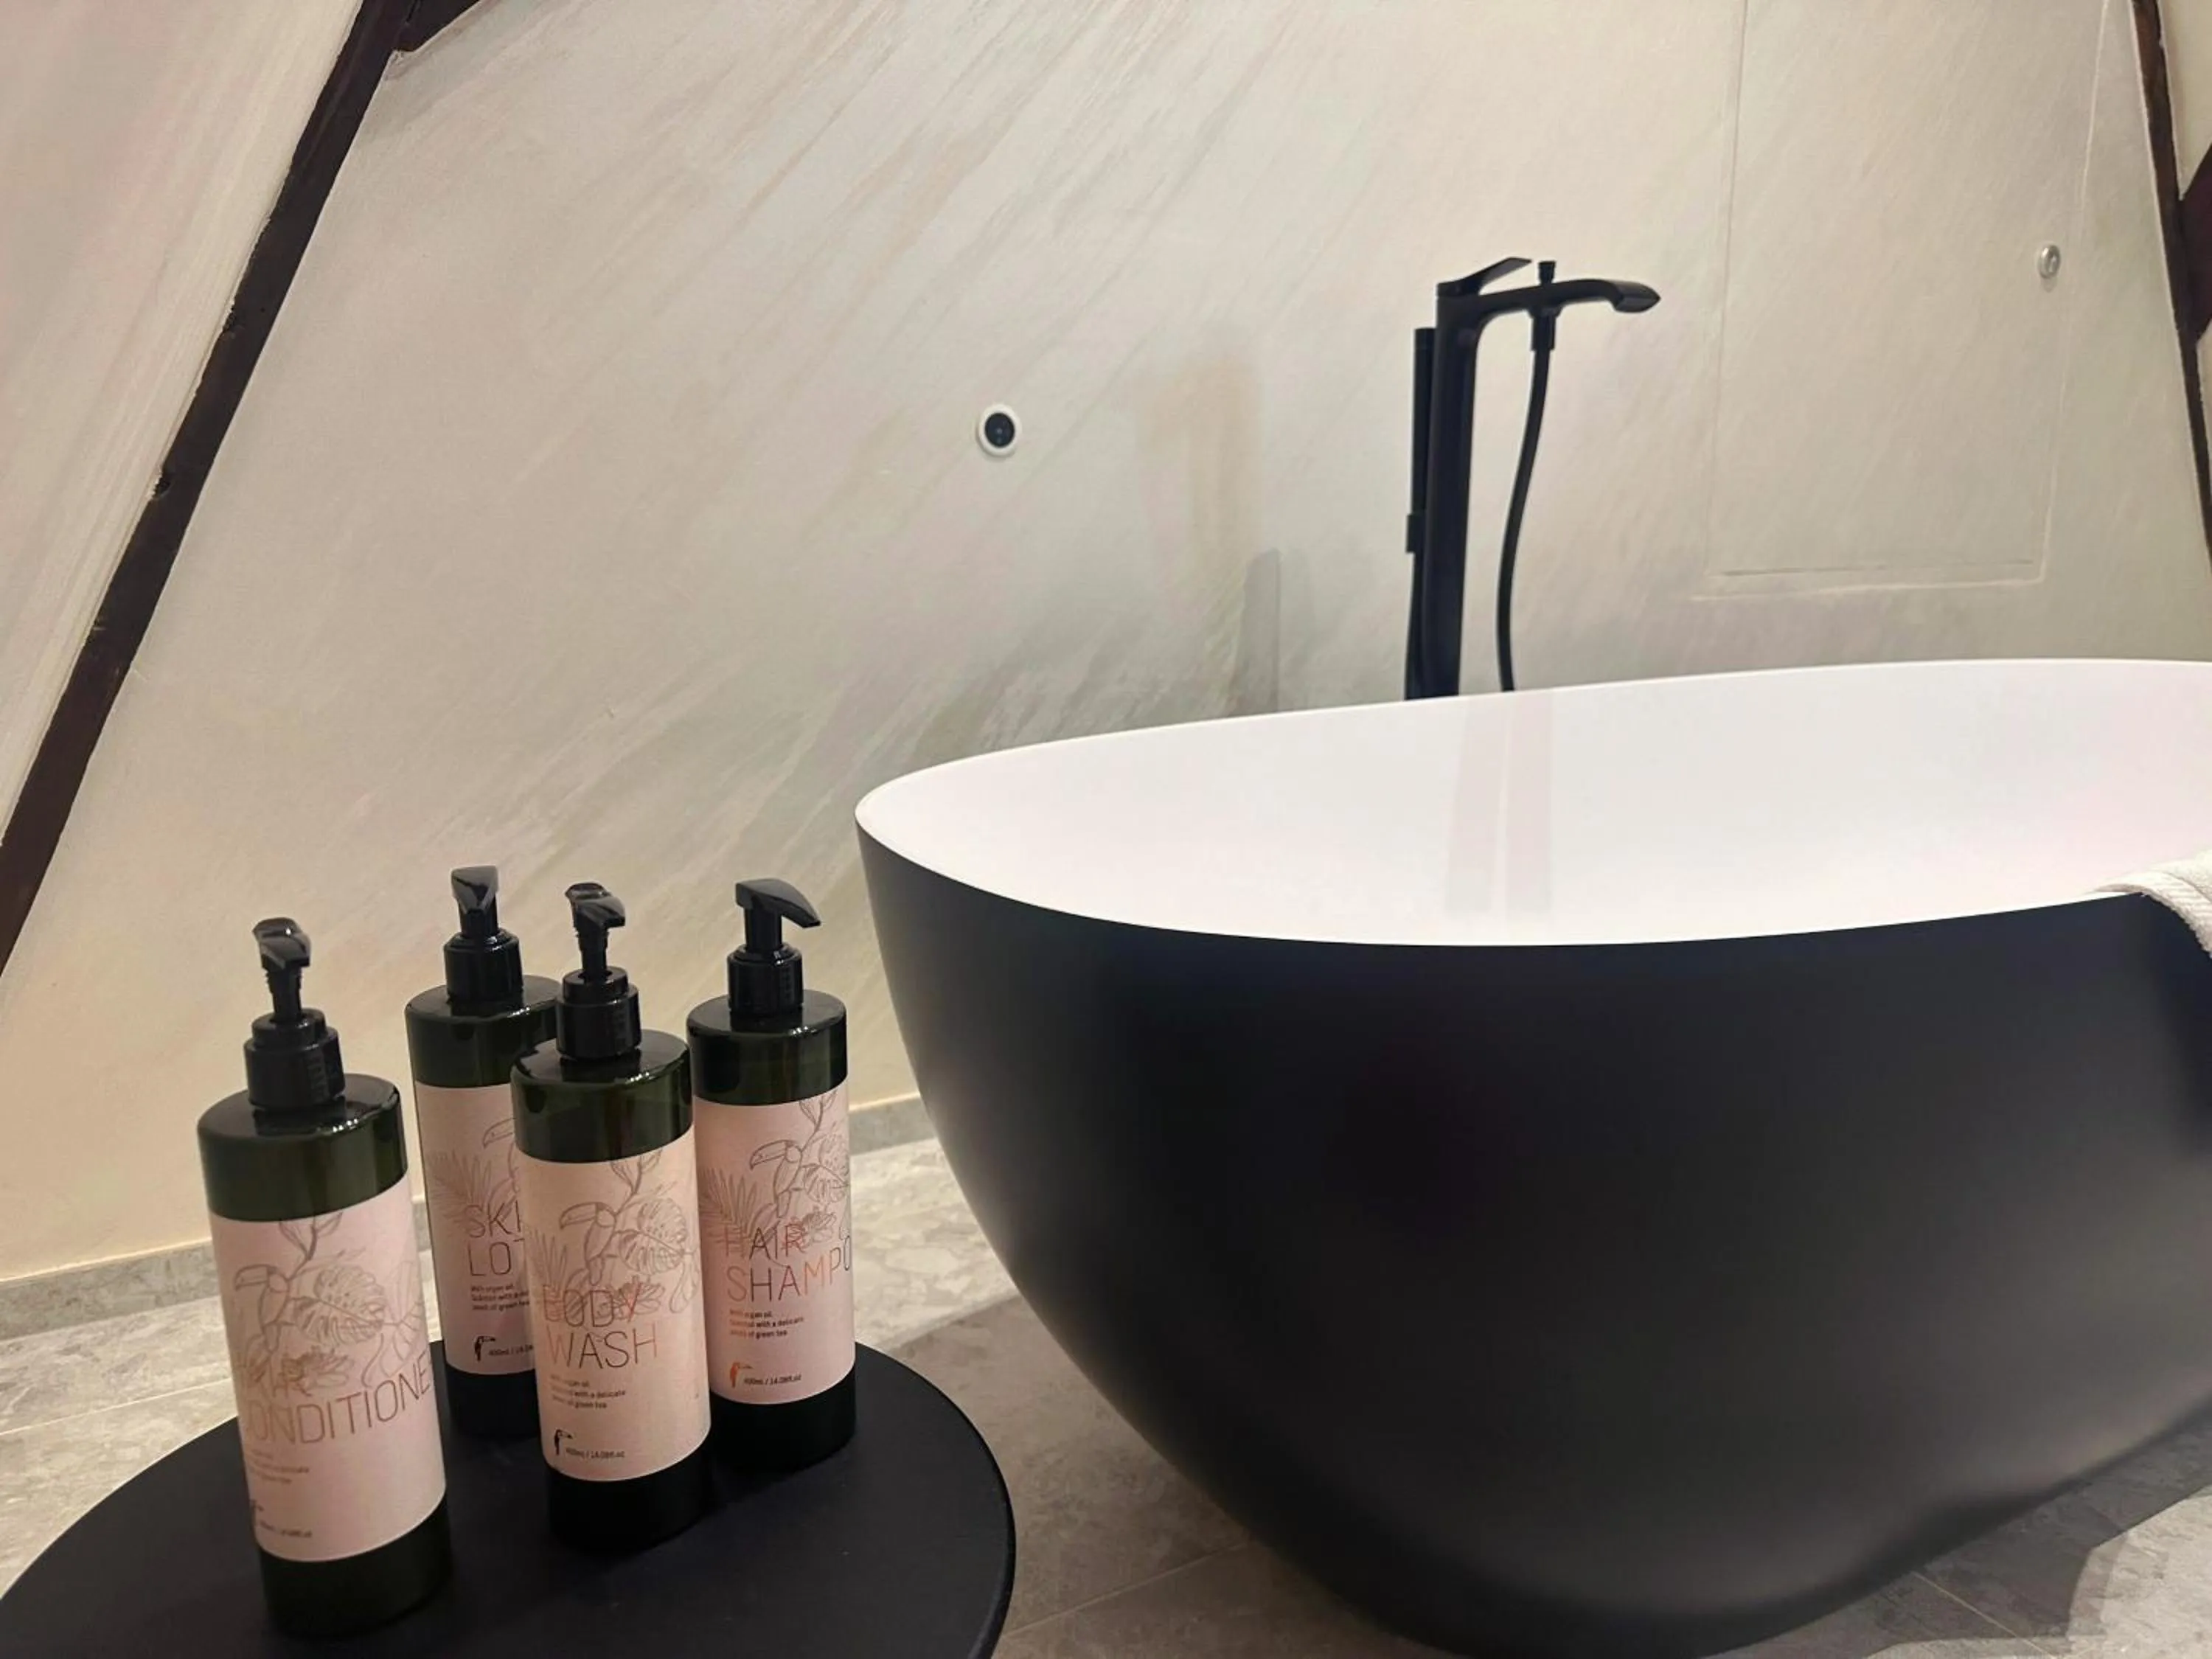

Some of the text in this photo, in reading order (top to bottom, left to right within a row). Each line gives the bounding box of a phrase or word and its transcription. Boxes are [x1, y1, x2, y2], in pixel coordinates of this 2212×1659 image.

[723, 1222, 806, 1260] HAIR
[542, 1282, 644, 1328] BODY
[545, 1322, 658, 1369] WASH
[246, 1349, 431, 1446] ONDITIONE
